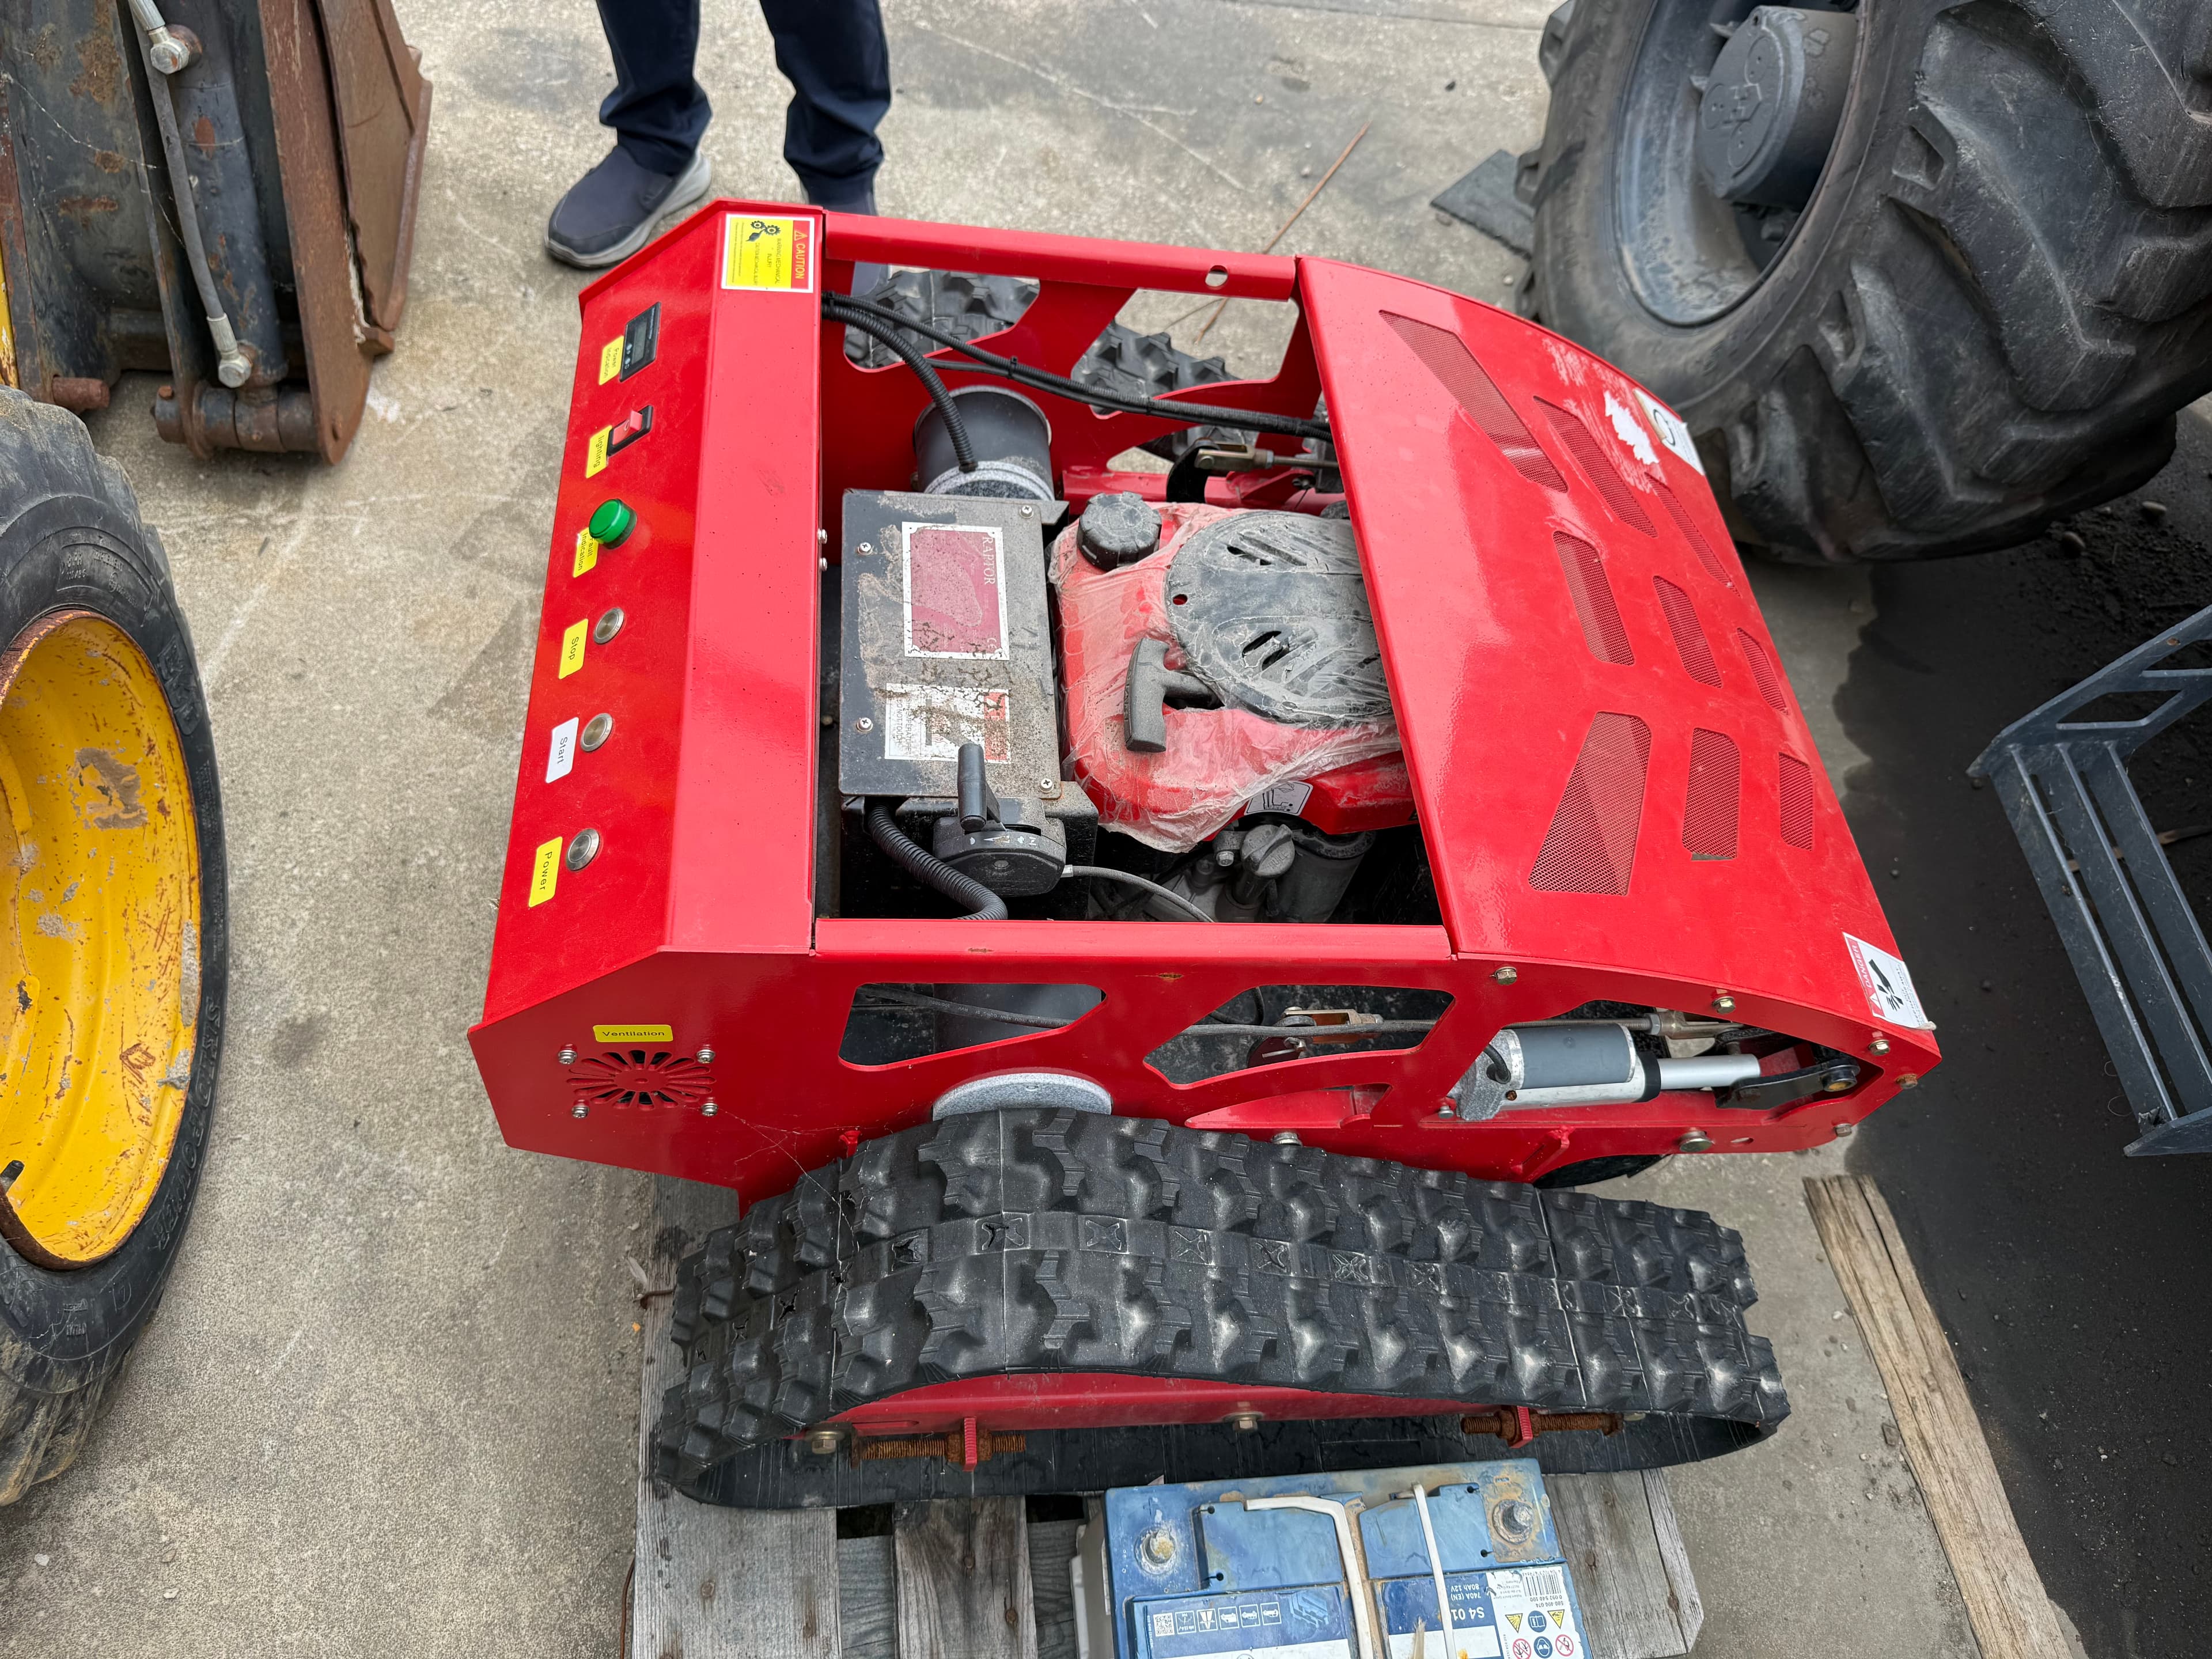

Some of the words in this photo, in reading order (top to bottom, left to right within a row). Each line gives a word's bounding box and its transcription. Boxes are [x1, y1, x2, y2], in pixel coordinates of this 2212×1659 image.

[795, 244, 806, 279] CAUTION
[593, 435, 605, 468] lighting
[578, 533, 588, 571] Indication
[982, 536, 995, 585] RAPTOR
[568, 636, 579, 660] Stop
[557, 737, 567, 764] Start
[539, 851, 552, 891] Power
[1851, 945, 1872, 988] DANGER
[1450, 1585, 1463, 1593] 12V
[1450, 1593, 1464, 1601] (EN)
[1468, 1606, 1485, 1619] S4
